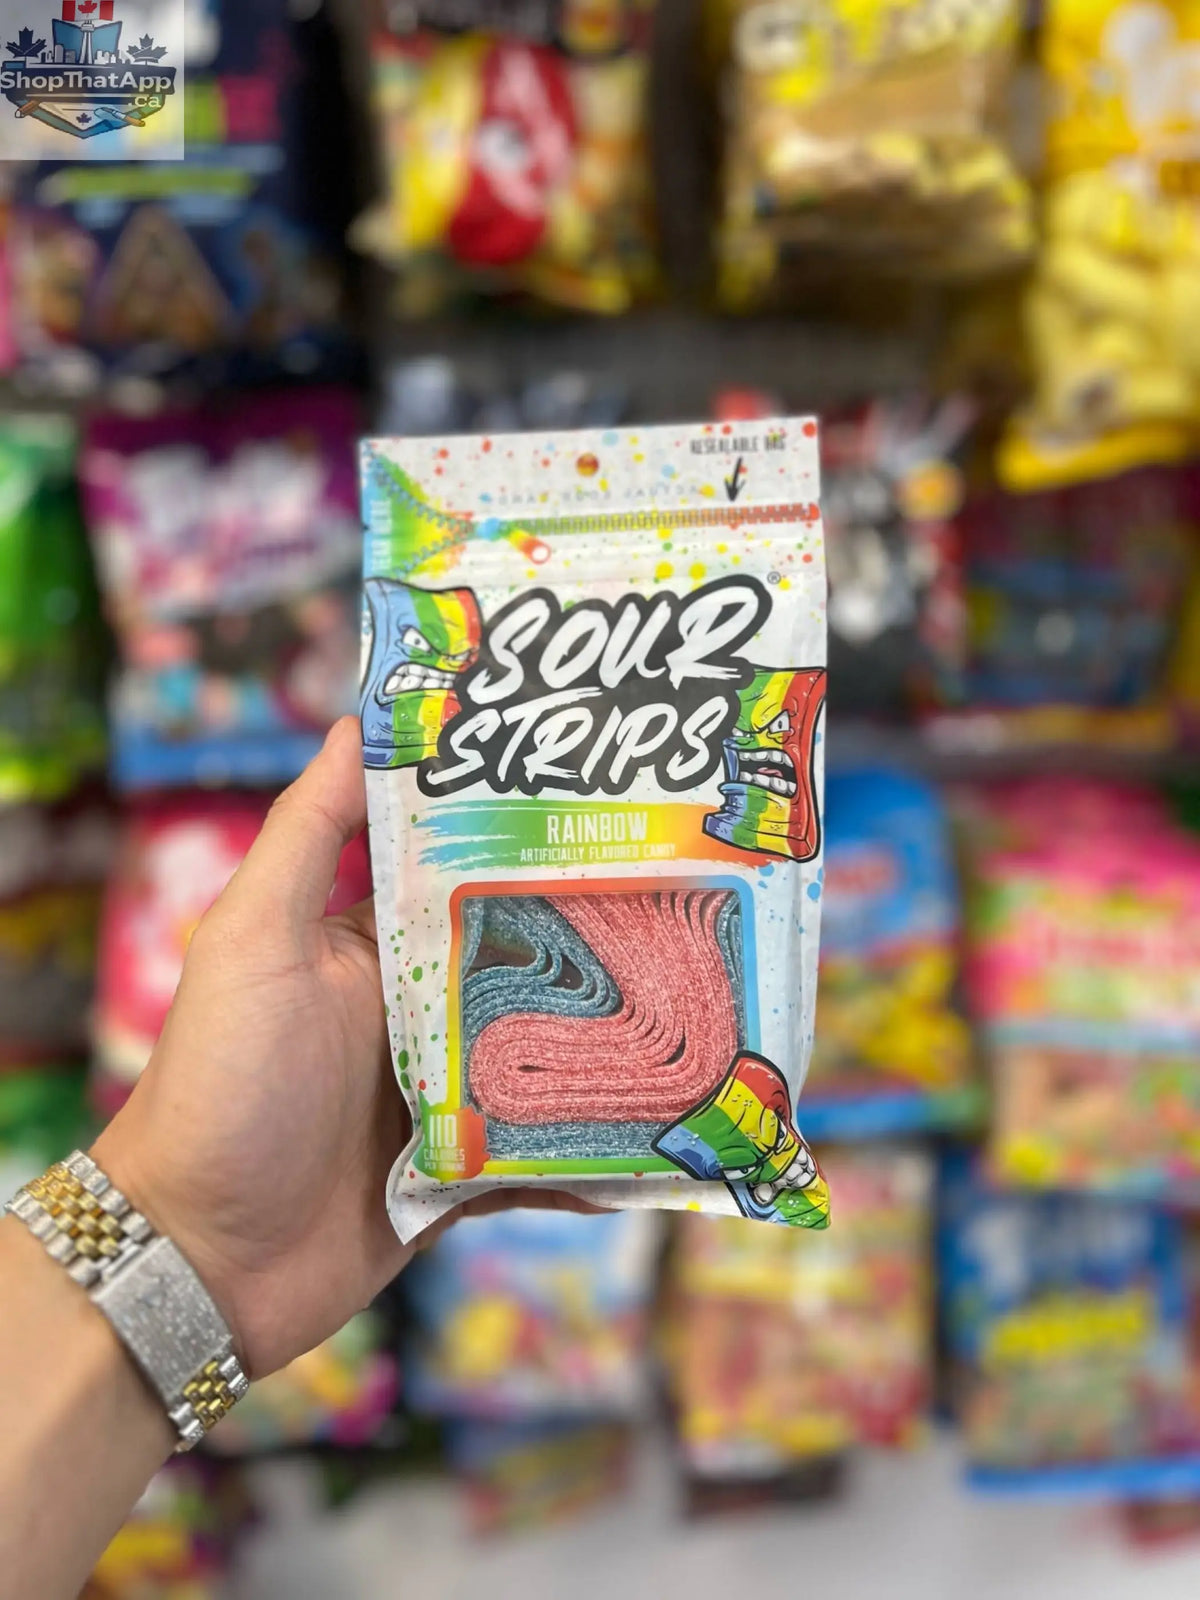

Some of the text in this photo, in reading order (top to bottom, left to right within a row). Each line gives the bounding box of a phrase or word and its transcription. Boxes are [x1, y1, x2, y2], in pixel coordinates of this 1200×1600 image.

[467, 585, 758, 705] SOUR
[427, 686, 730, 786] STRIPS
[547, 812, 648, 844] RAINBOW
[520, 847, 585, 863] ARTIFICIALLY
[589, 845, 640, 860] FLAVORED
[429, 1114, 457, 1148] 110
